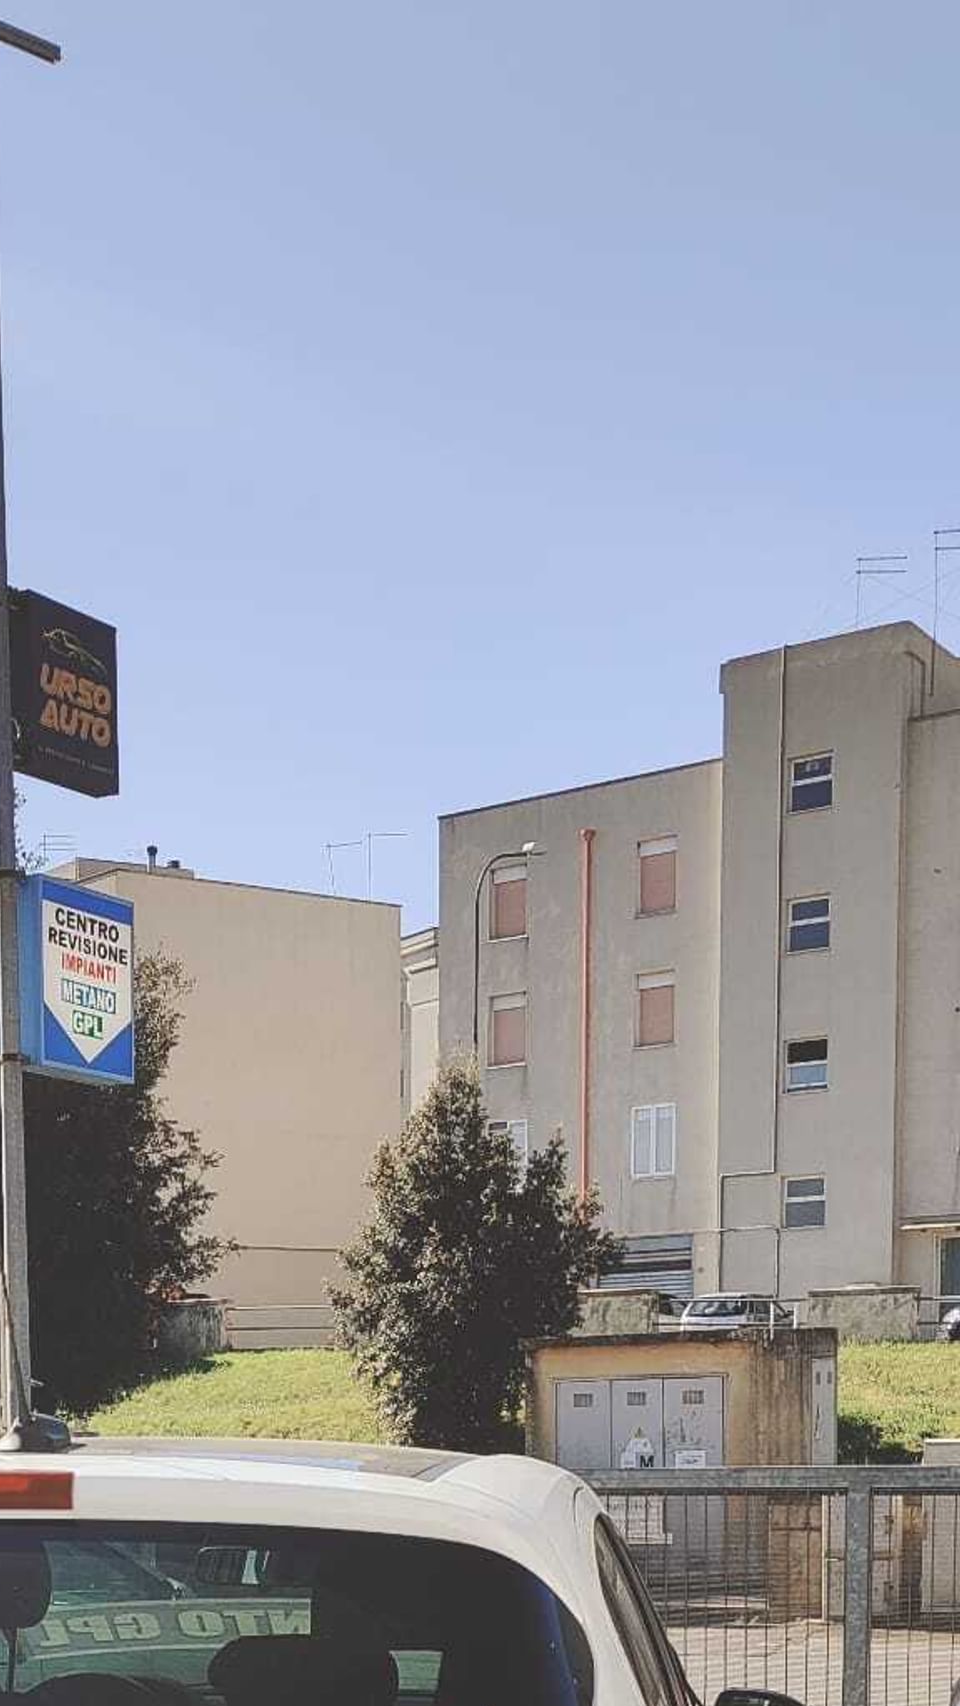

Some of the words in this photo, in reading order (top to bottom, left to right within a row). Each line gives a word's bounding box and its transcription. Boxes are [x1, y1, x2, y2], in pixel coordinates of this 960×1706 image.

[40, 662, 111, 715] URSO
[41, 699, 111, 748] AUTO
[55, 907, 119, 943] CENTRO
[48, 927, 128, 965] REVISIONE
[61, 952, 117, 984] IMPIANTI
[61, 979, 116, 1014] METANO
[72, 1010, 103, 1038] GPL
